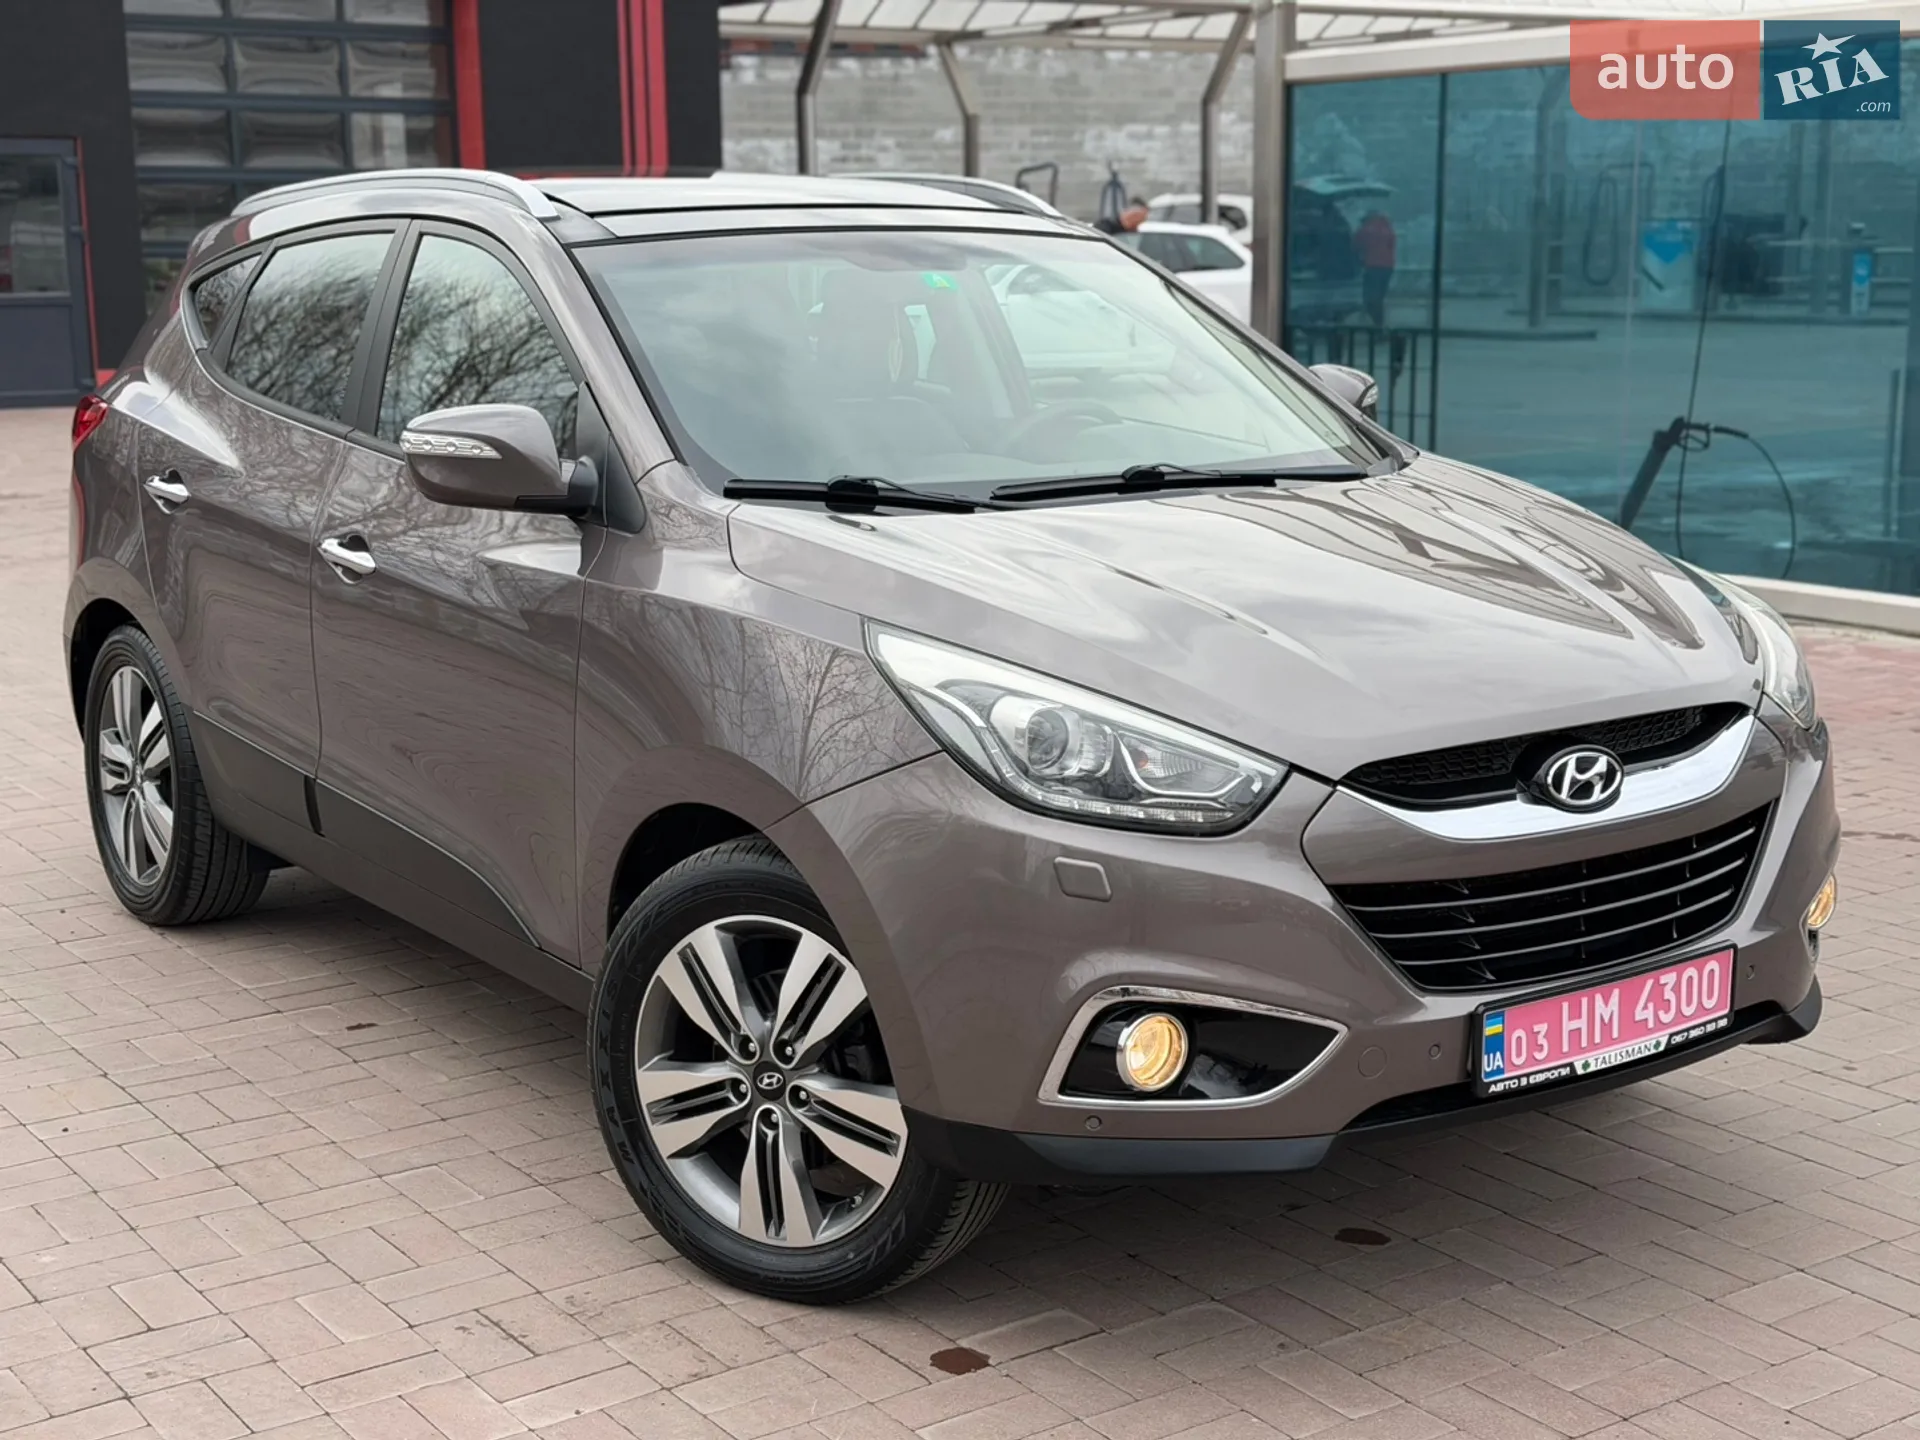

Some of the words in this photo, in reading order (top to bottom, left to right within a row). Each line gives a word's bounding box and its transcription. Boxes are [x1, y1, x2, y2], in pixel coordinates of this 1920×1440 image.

[1510, 1022, 1549, 1067] 03
[1561, 987, 1620, 1054] HM
[1633, 959, 1721, 1030] 4300
[1483, 1053, 1505, 1073] UA
[1593, 1042, 1653, 1068] TALISMAN
